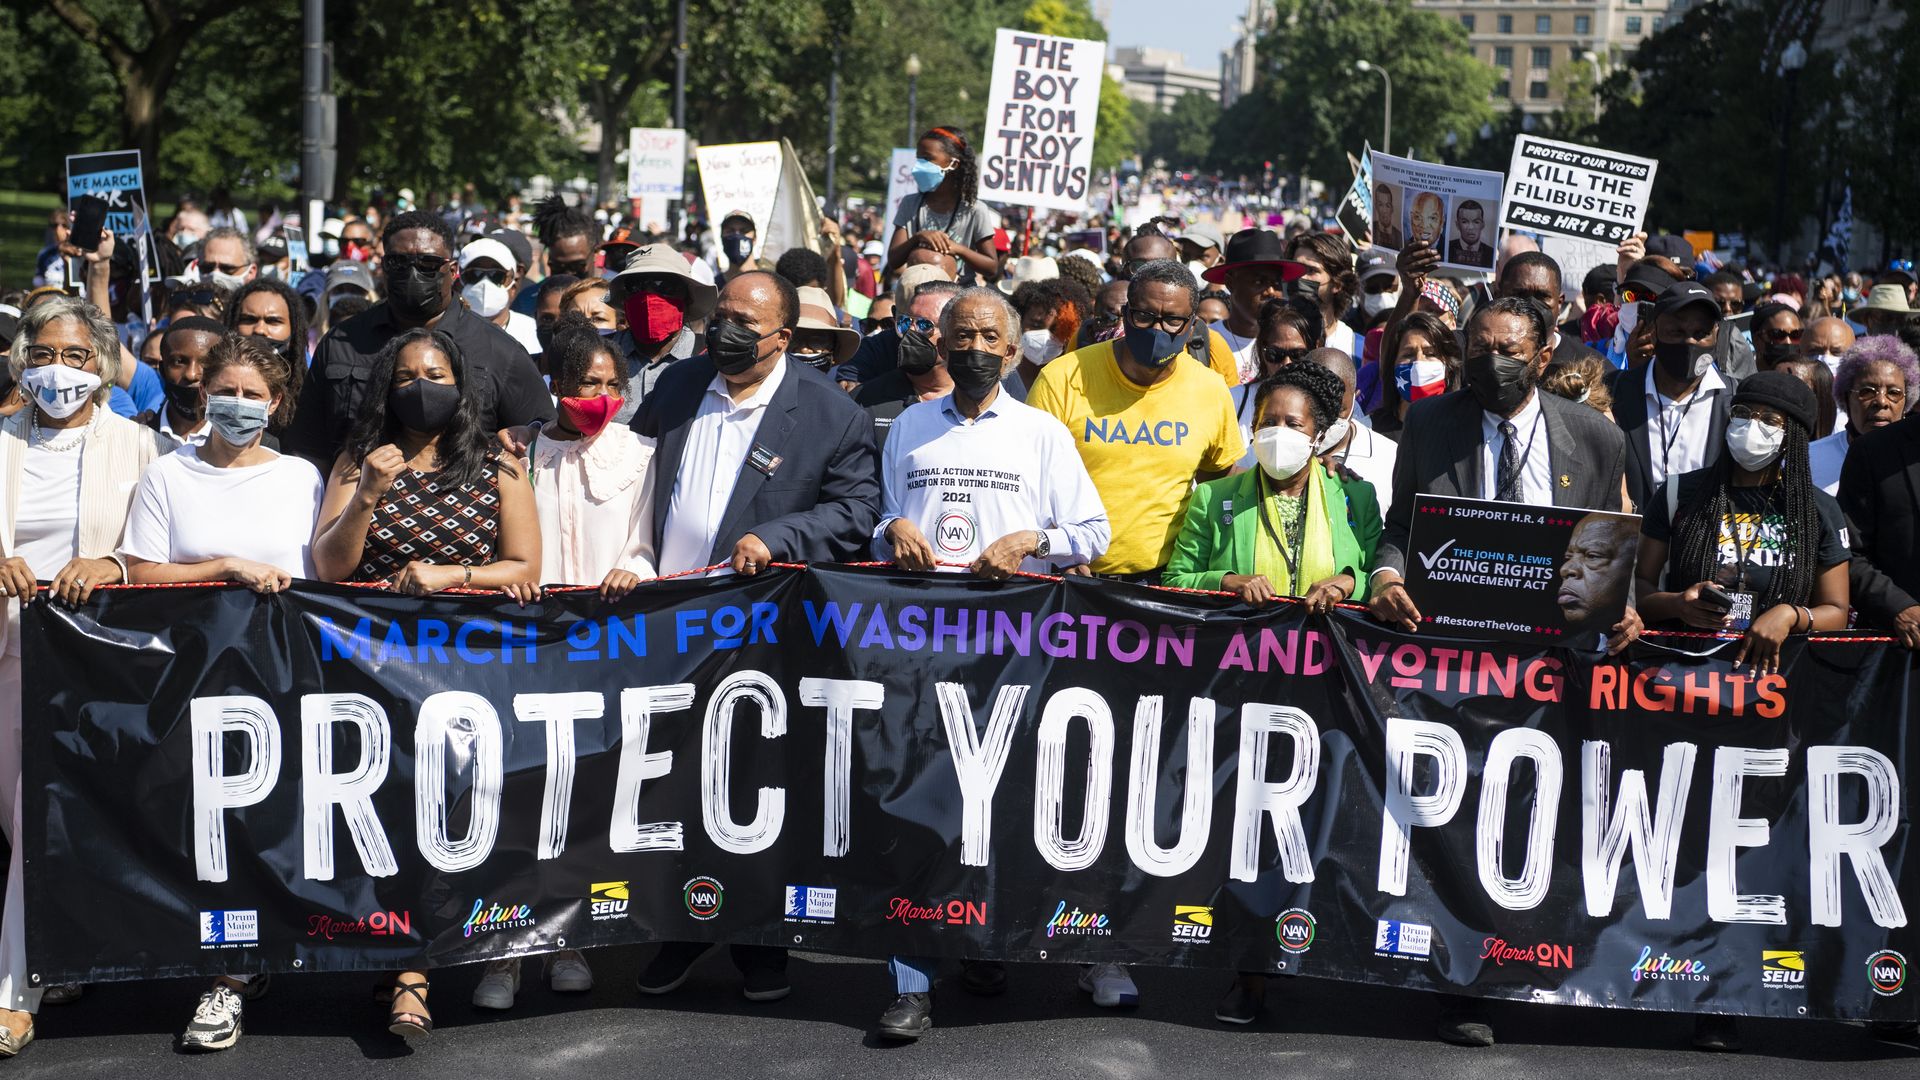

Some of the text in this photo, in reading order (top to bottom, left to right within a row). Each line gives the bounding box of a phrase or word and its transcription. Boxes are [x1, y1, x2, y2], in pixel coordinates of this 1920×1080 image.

[1013, 36, 1074, 72] THE
[1012, 69, 1079, 104] BOY
[1002, 103, 1076, 132] FROM
[998, 129, 1082, 164] TROY
[1526, 145, 1647, 176] PROTECT OUR VOTES
[72, 174, 138, 189] WE MARCH
[983, 155, 1086, 200] SENTUS
[1428, 174, 1452, 182] POWERFUL
[1453, 177, 1482, 185] NONVIOLENT
[1527, 162, 1633, 197] KILL THE
[1514, 182, 1637, 219] FILIBUSTER
[1511, 207, 1631, 240] Pass HR1 & S1
[1084, 417, 1188, 446] NAACP
[907, 468, 1020, 482] NATIONAL ACTION NETWORK
[907, 478, 1020, 492] MARCH ON FOR VOTING RIGHTS
[942, 492, 971, 503] 2021
[1448, 507, 1544, 524] I SUPPORT H.R. 4
[941, 527, 969, 540] NAN
[1453, 548, 1552, 566] THE JOHN R. LEWIS
[1494, 563, 1553, 579] RIGHTS
[1428, 570, 1548, 590] ADVANCEMENT ACT
[1435, 615, 1532, 633] #RestoreTheVote
[318, 600, 1788, 719] MARCH ON FOR WASHINGTON AND VOTING RIGHTS
[190, 669, 1908, 930] PROTECT YOUR POWER
[691, 892, 716, 905] NAN
[809, 890, 834, 898] Drum
[591, 900, 628, 915] SEIU
[810, 899, 834, 907] Major
[227, 913, 255, 921] Drum
[463, 898, 530, 938] future
[886, 897, 987, 926] March ON
[1047, 900, 1109, 937] future
[227, 922, 255, 930] Major
[308, 911, 410, 940] March ON
[474, 919, 536, 933] COALITION
[1056, 927, 1112, 936] COALITION
[1172, 925, 1212, 937] SEIU
[1283, 924, 1308, 938] NAN
[1403, 925, 1429, 935] Drum
[1402, 934, 1428, 943] Major
[1401, 943, 1427, 951] Institute
[1480, 937, 1572, 969] March ON
[1631, 946, 1705, 982] future
[1643, 972, 1710, 982] COALITION
[1762, 971, 1804, 982] SEIU
[1874, 966, 1900, 980] NAN
